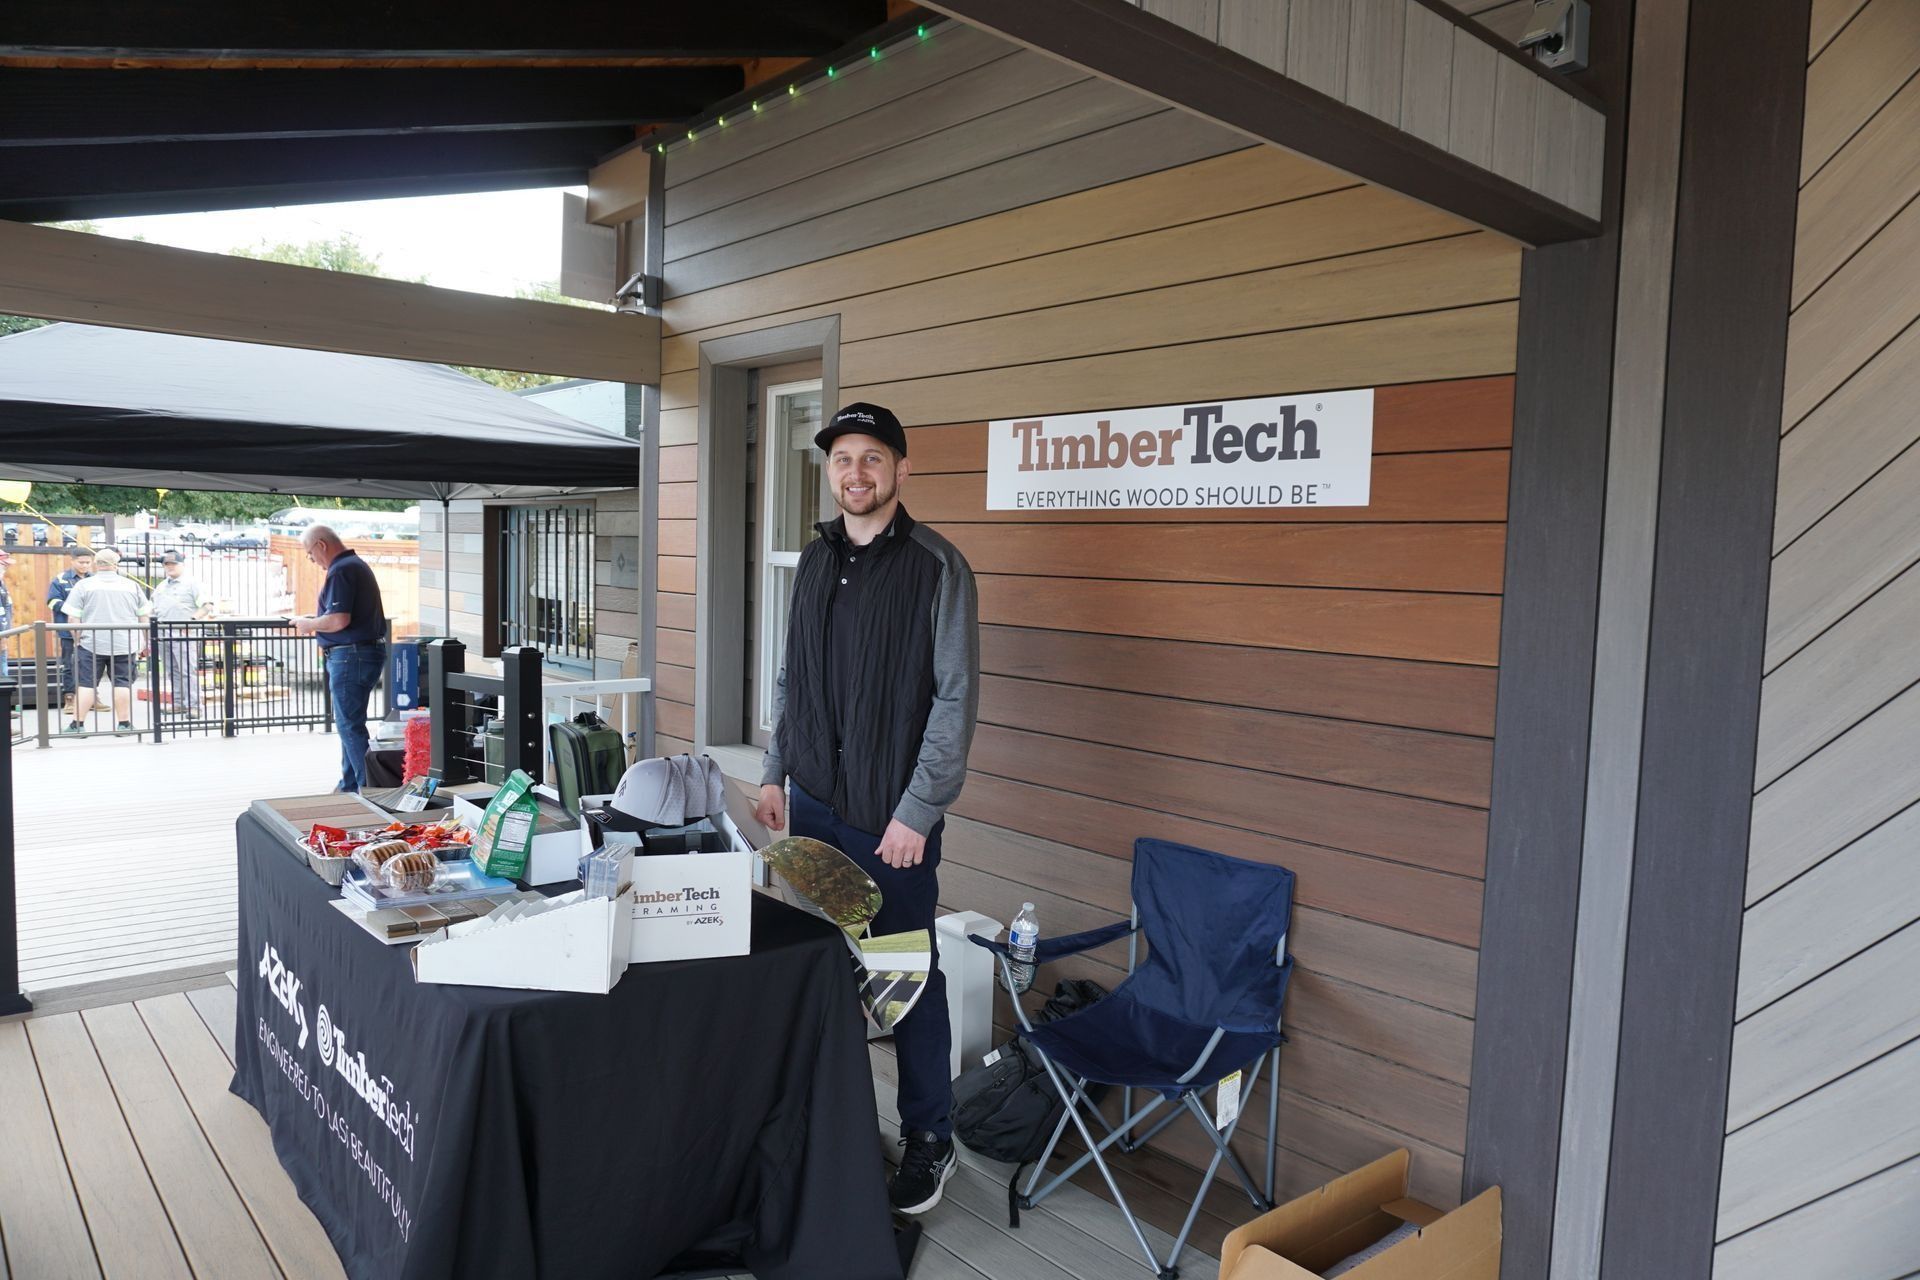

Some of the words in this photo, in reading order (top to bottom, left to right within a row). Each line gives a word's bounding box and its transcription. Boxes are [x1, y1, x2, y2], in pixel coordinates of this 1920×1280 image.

[1012, 404, 1321, 472] TimberTech
[1016, 489, 1121, 508] EVERYTHING
[1127, 487, 1189, 507] WOOD
[1195, 485, 1283, 506] SHOULD
[633, 887, 720, 904] imberTech
[694, 916, 719, 925] AZEK
[259, 1017, 311, 1100] ENGINEERED
[311, 1084, 325, 1119] TO
